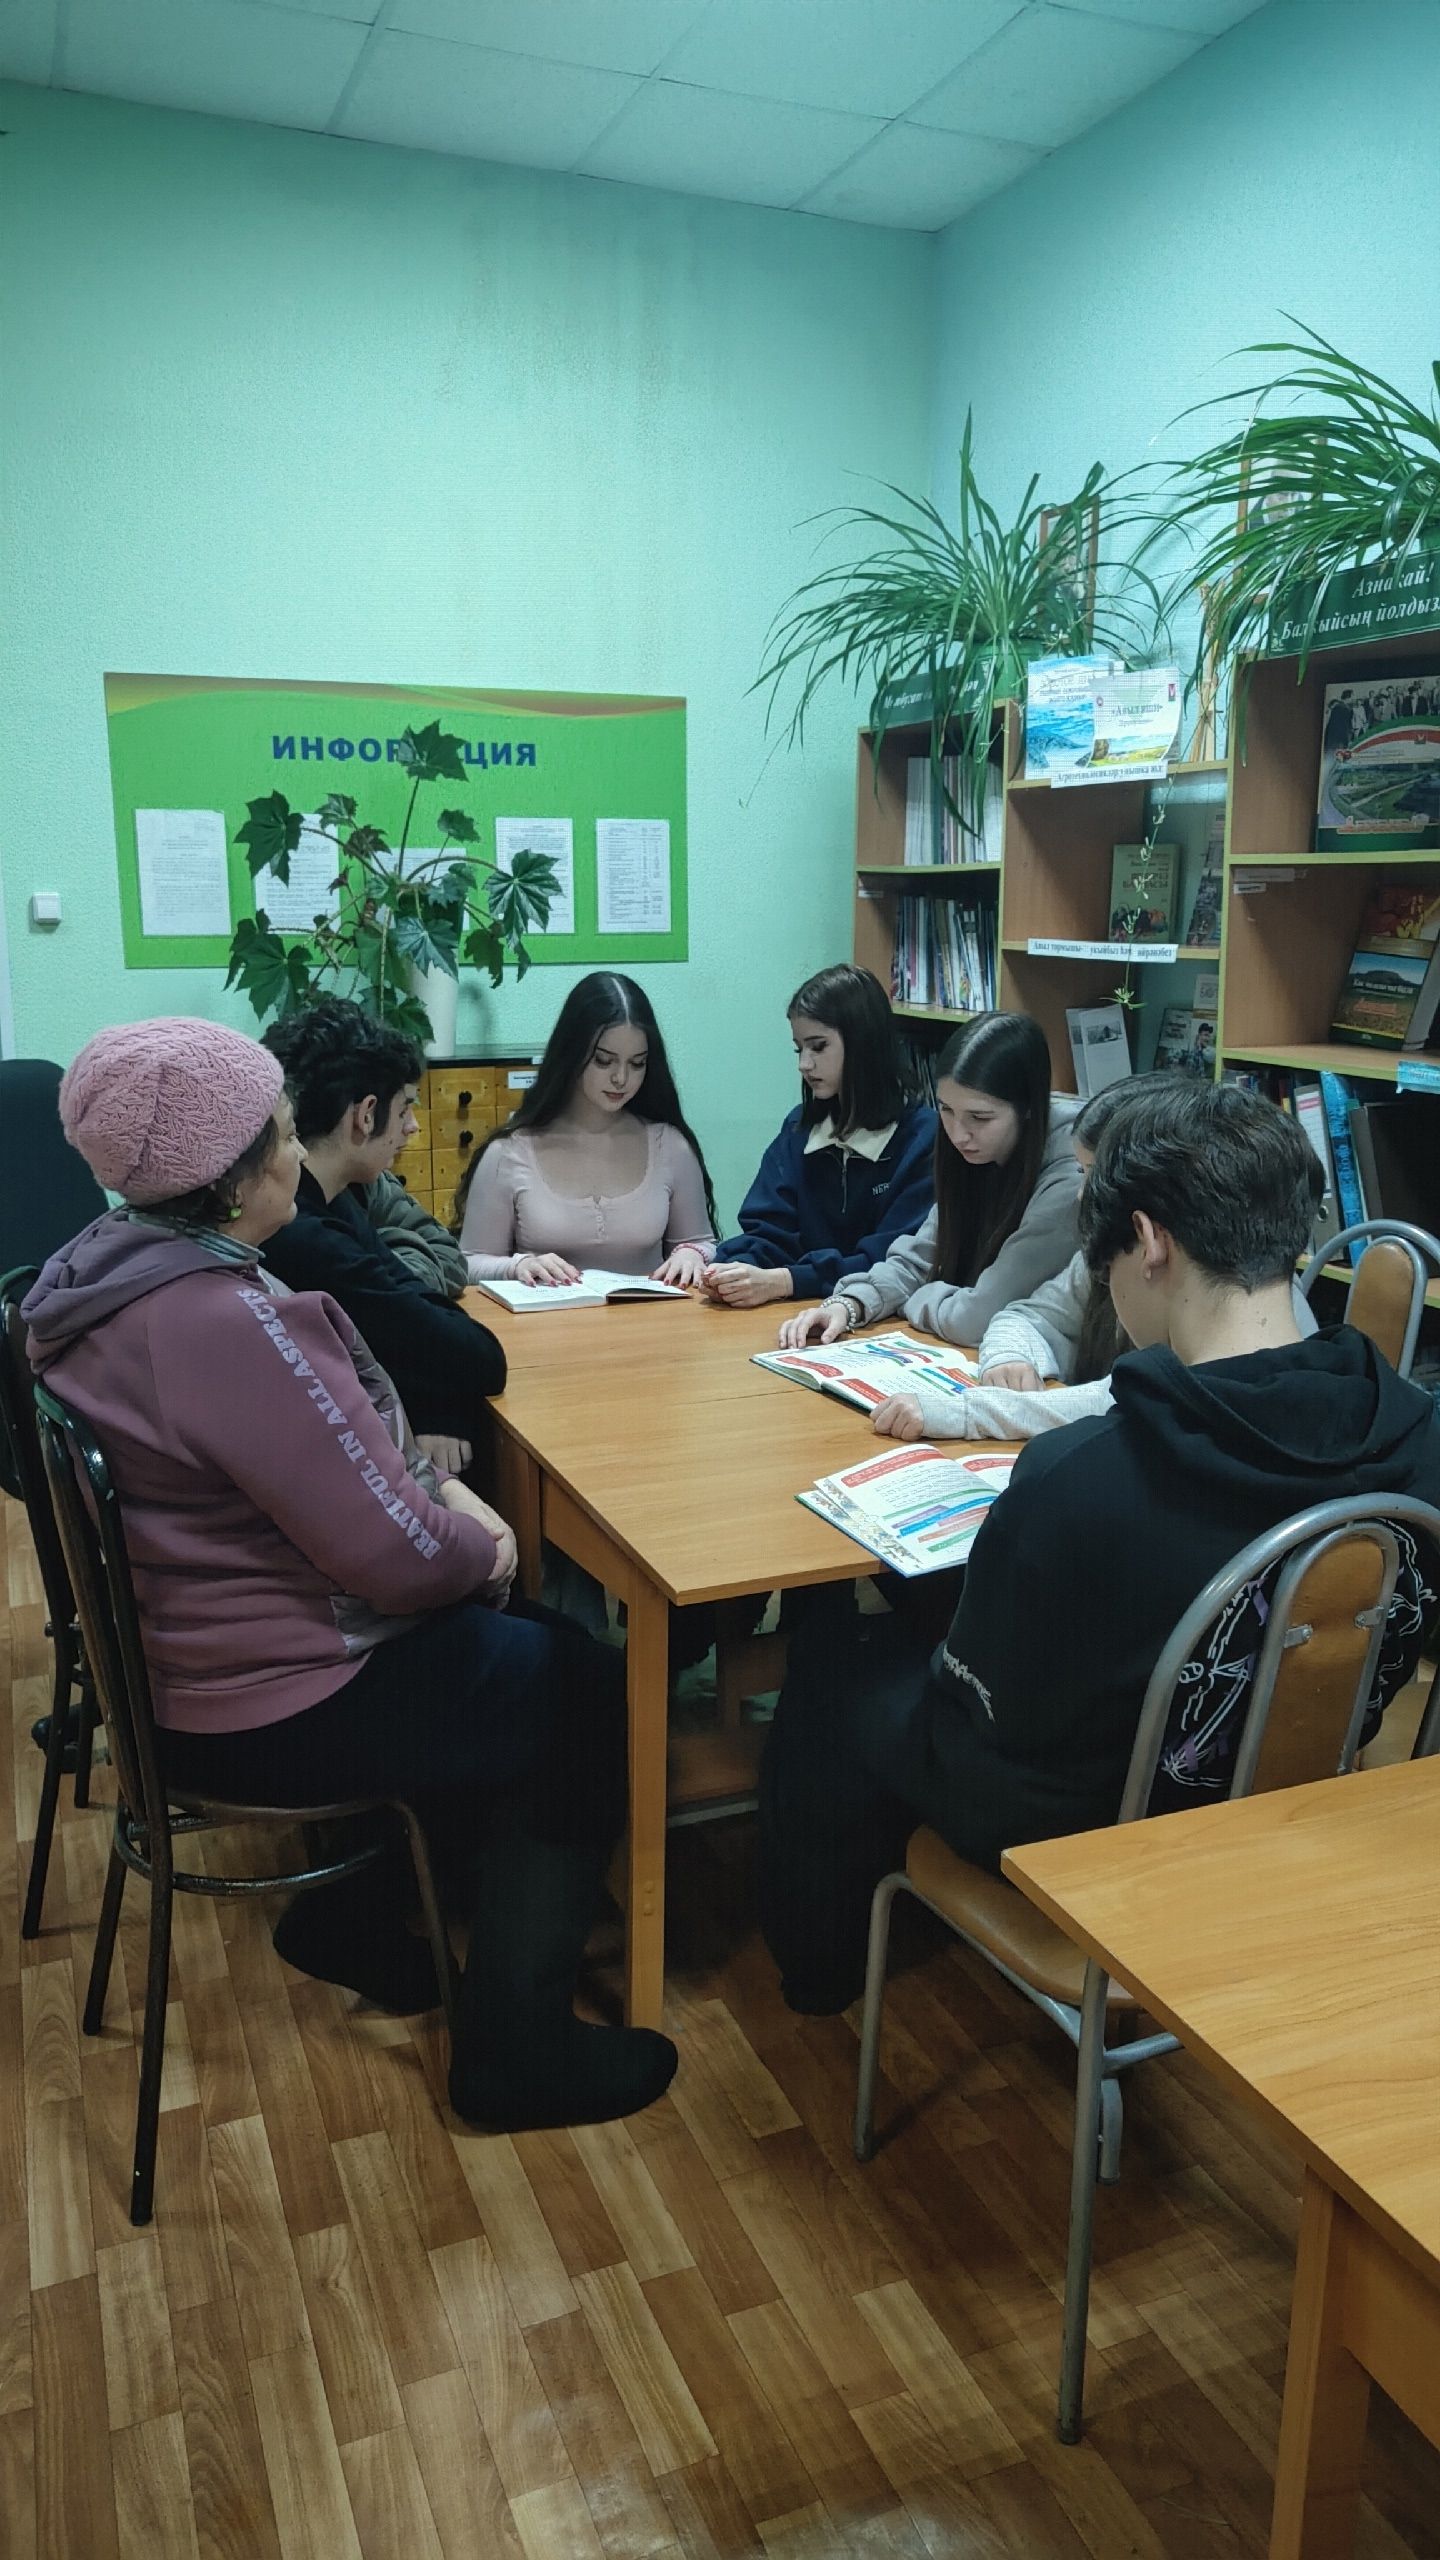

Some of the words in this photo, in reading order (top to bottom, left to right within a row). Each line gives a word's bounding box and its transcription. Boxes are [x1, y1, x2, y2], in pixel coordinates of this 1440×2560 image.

[1375, 596, 1440, 623] йолдыз
[272, 735, 537, 770] ИНФОРЦИЯ
[235, 1287, 317, 1379] ASPECTS
[306, 1378, 348, 1425] ALL
[337, 1430, 367, 1463] IN
